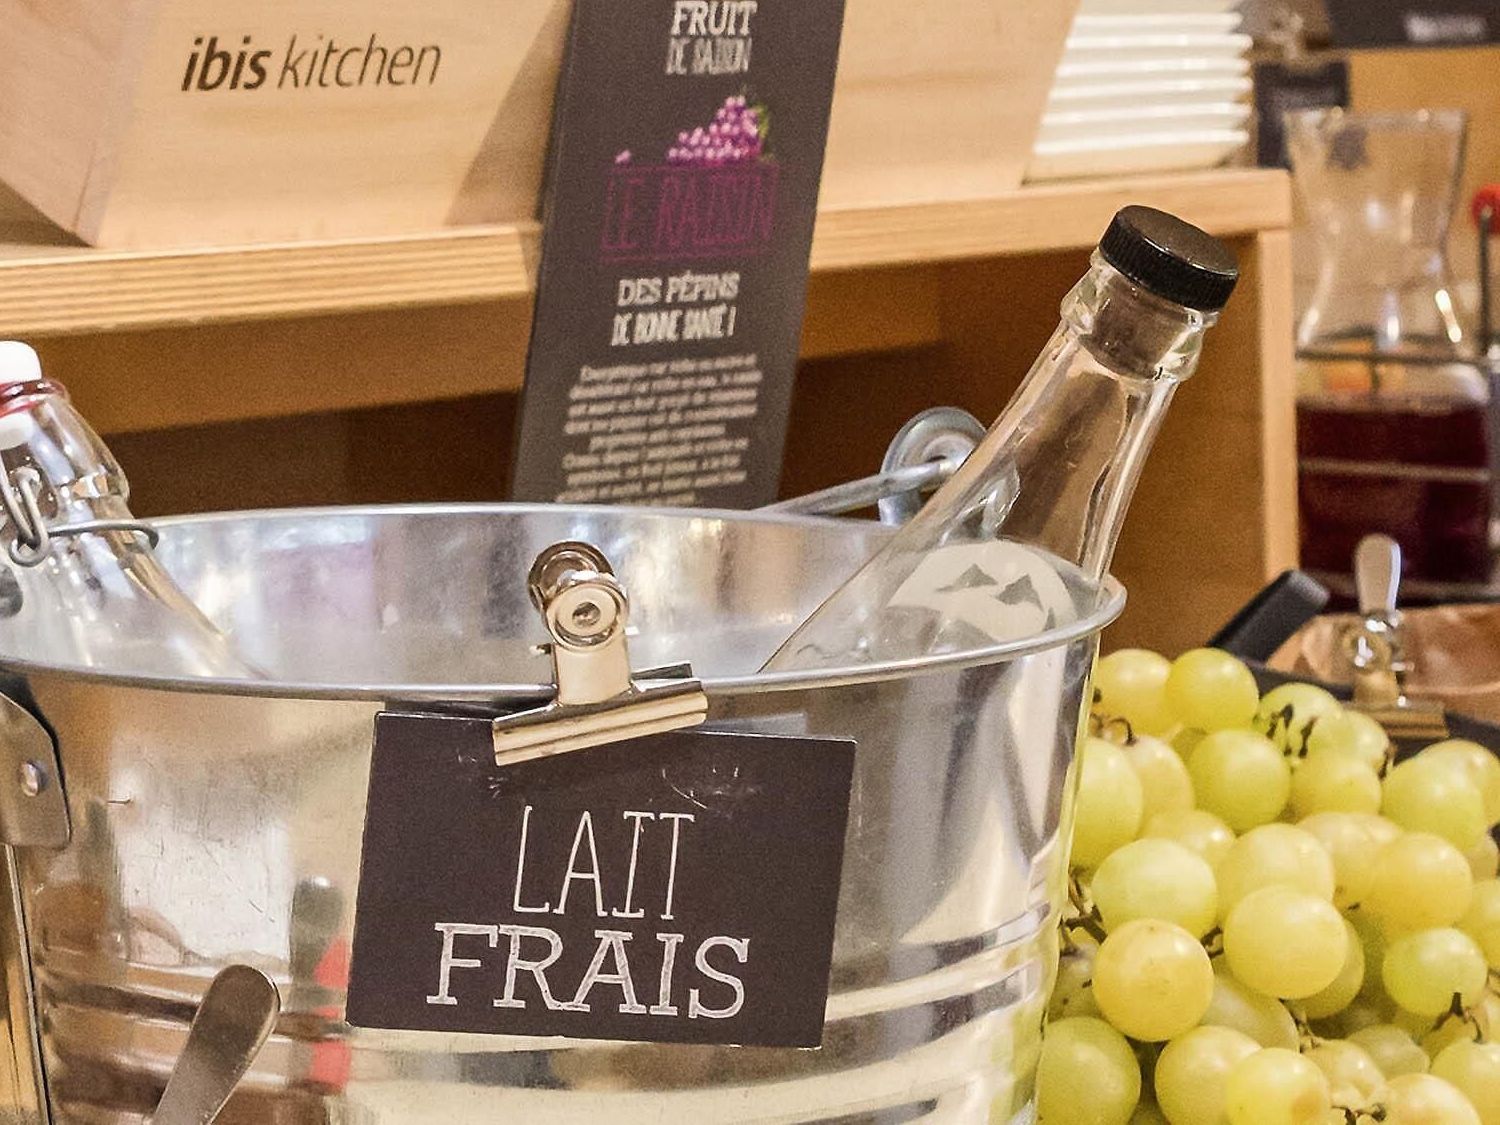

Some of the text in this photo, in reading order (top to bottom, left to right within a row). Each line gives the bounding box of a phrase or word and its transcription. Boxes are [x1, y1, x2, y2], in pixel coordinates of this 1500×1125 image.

[670, 0, 758, 36] FRUIT
[181, 33, 441, 92] ibis kitchen
[617, 277, 662, 307] DES
[513, 805, 695, 920] LAIT
[426, 921, 750, 1020] FRAIS
